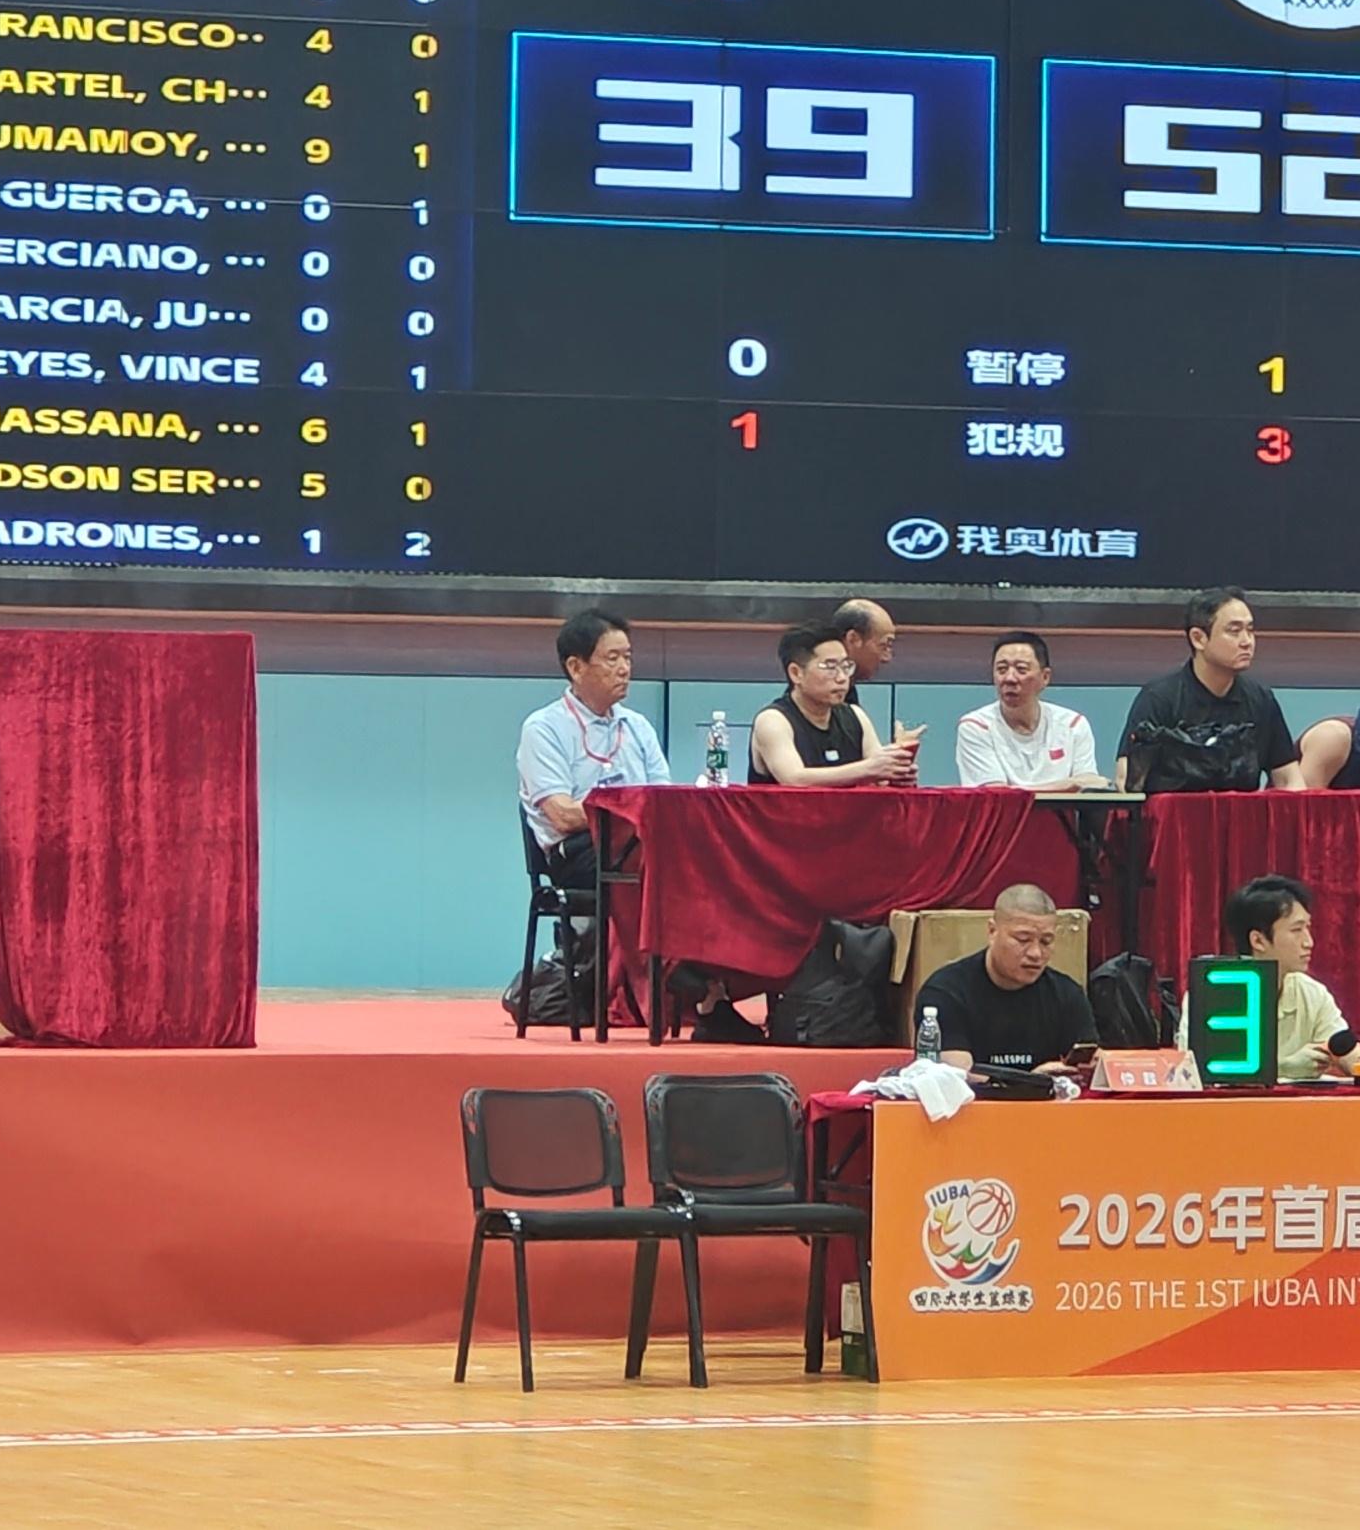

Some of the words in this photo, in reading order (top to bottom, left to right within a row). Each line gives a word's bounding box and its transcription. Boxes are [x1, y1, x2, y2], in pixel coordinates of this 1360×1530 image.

[307, 30, 332, 52] 4
[305, 86, 331, 108] 4
[415, 91, 428, 112] 1
[595, 79, 914, 198] 39
[305, 139, 329, 163] 9
[415, 145, 427, 167] 1
[304, 195, 330, 220] 0
[302, 251, 329, 277] 0
[302, 307, 328, 332] 0
[121, 355, 260, 384] VINCE
[301, 362, 328, 386] 4
[411, 366, 425, 389] 1
[729, 339, 767, 376] 0
[967, 350, 1065, 385] 暂停
[1260, 358, 1283, 392] 1
[302, 419, 326, 442] 6
[412, 423, 425, 445] 1
[732, 413, 756, 448] 1
[967, 422, 1064, 457] 犯规
[1258, 428, 1291, 463] 3
[302, 474, 325, 497] 5
[303, 530, 320, 553] 1
[957, 526, 1137, 557] 我奥体育
[1206, 970, 1261, 1074] 3
[930, 1184, 970, 1207] IUBA
[1056, 1282, 1122, 1311] 2026
[1129, 1281, 1186, 1309] THE
[1195, 1280, 1245, 1308] 1ST
[1253, 1279, 1321, 1307] IUBA
